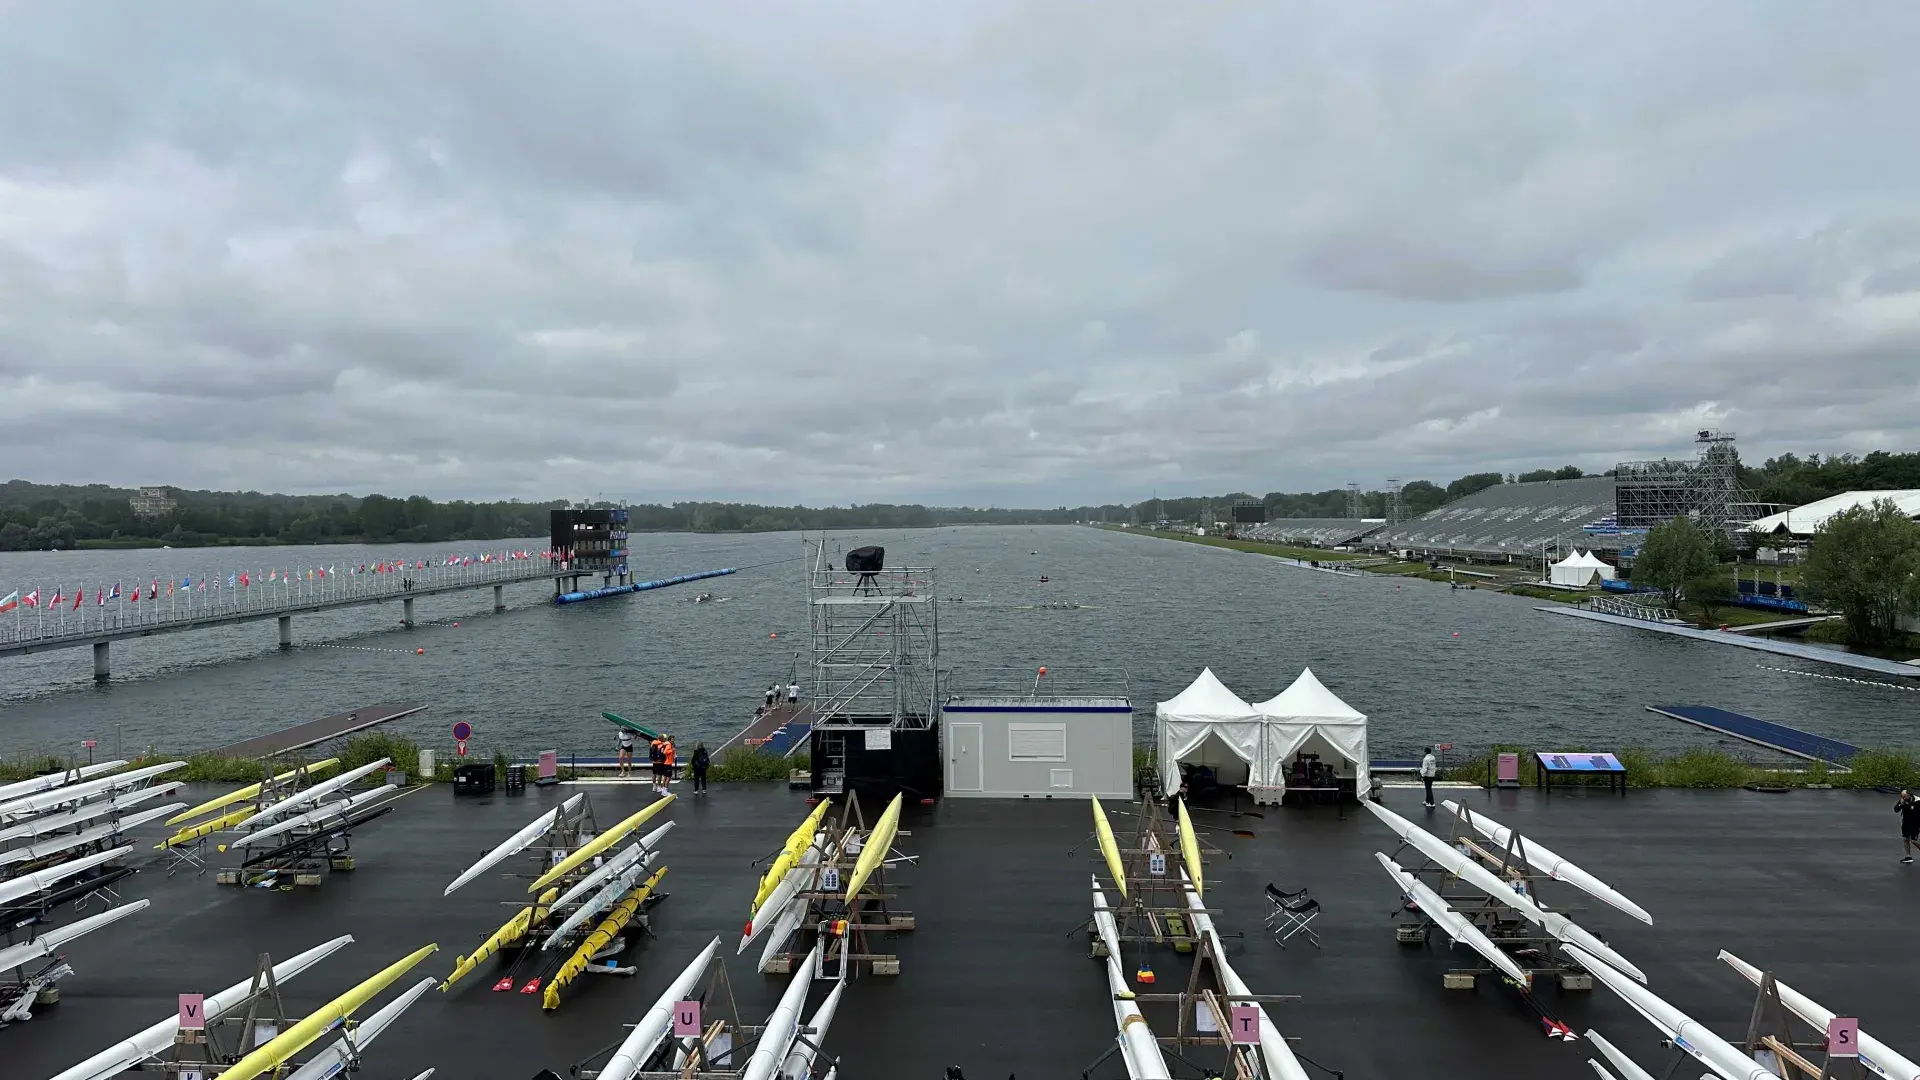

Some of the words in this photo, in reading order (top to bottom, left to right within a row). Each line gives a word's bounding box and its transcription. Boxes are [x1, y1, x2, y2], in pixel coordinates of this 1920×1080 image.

[186, 1004, 197, 1018] V
[681, 1012, 693, 1026] U
[1240, 1018, 1252, 1031] T
[1839, 1029, 1849, 1044] S
